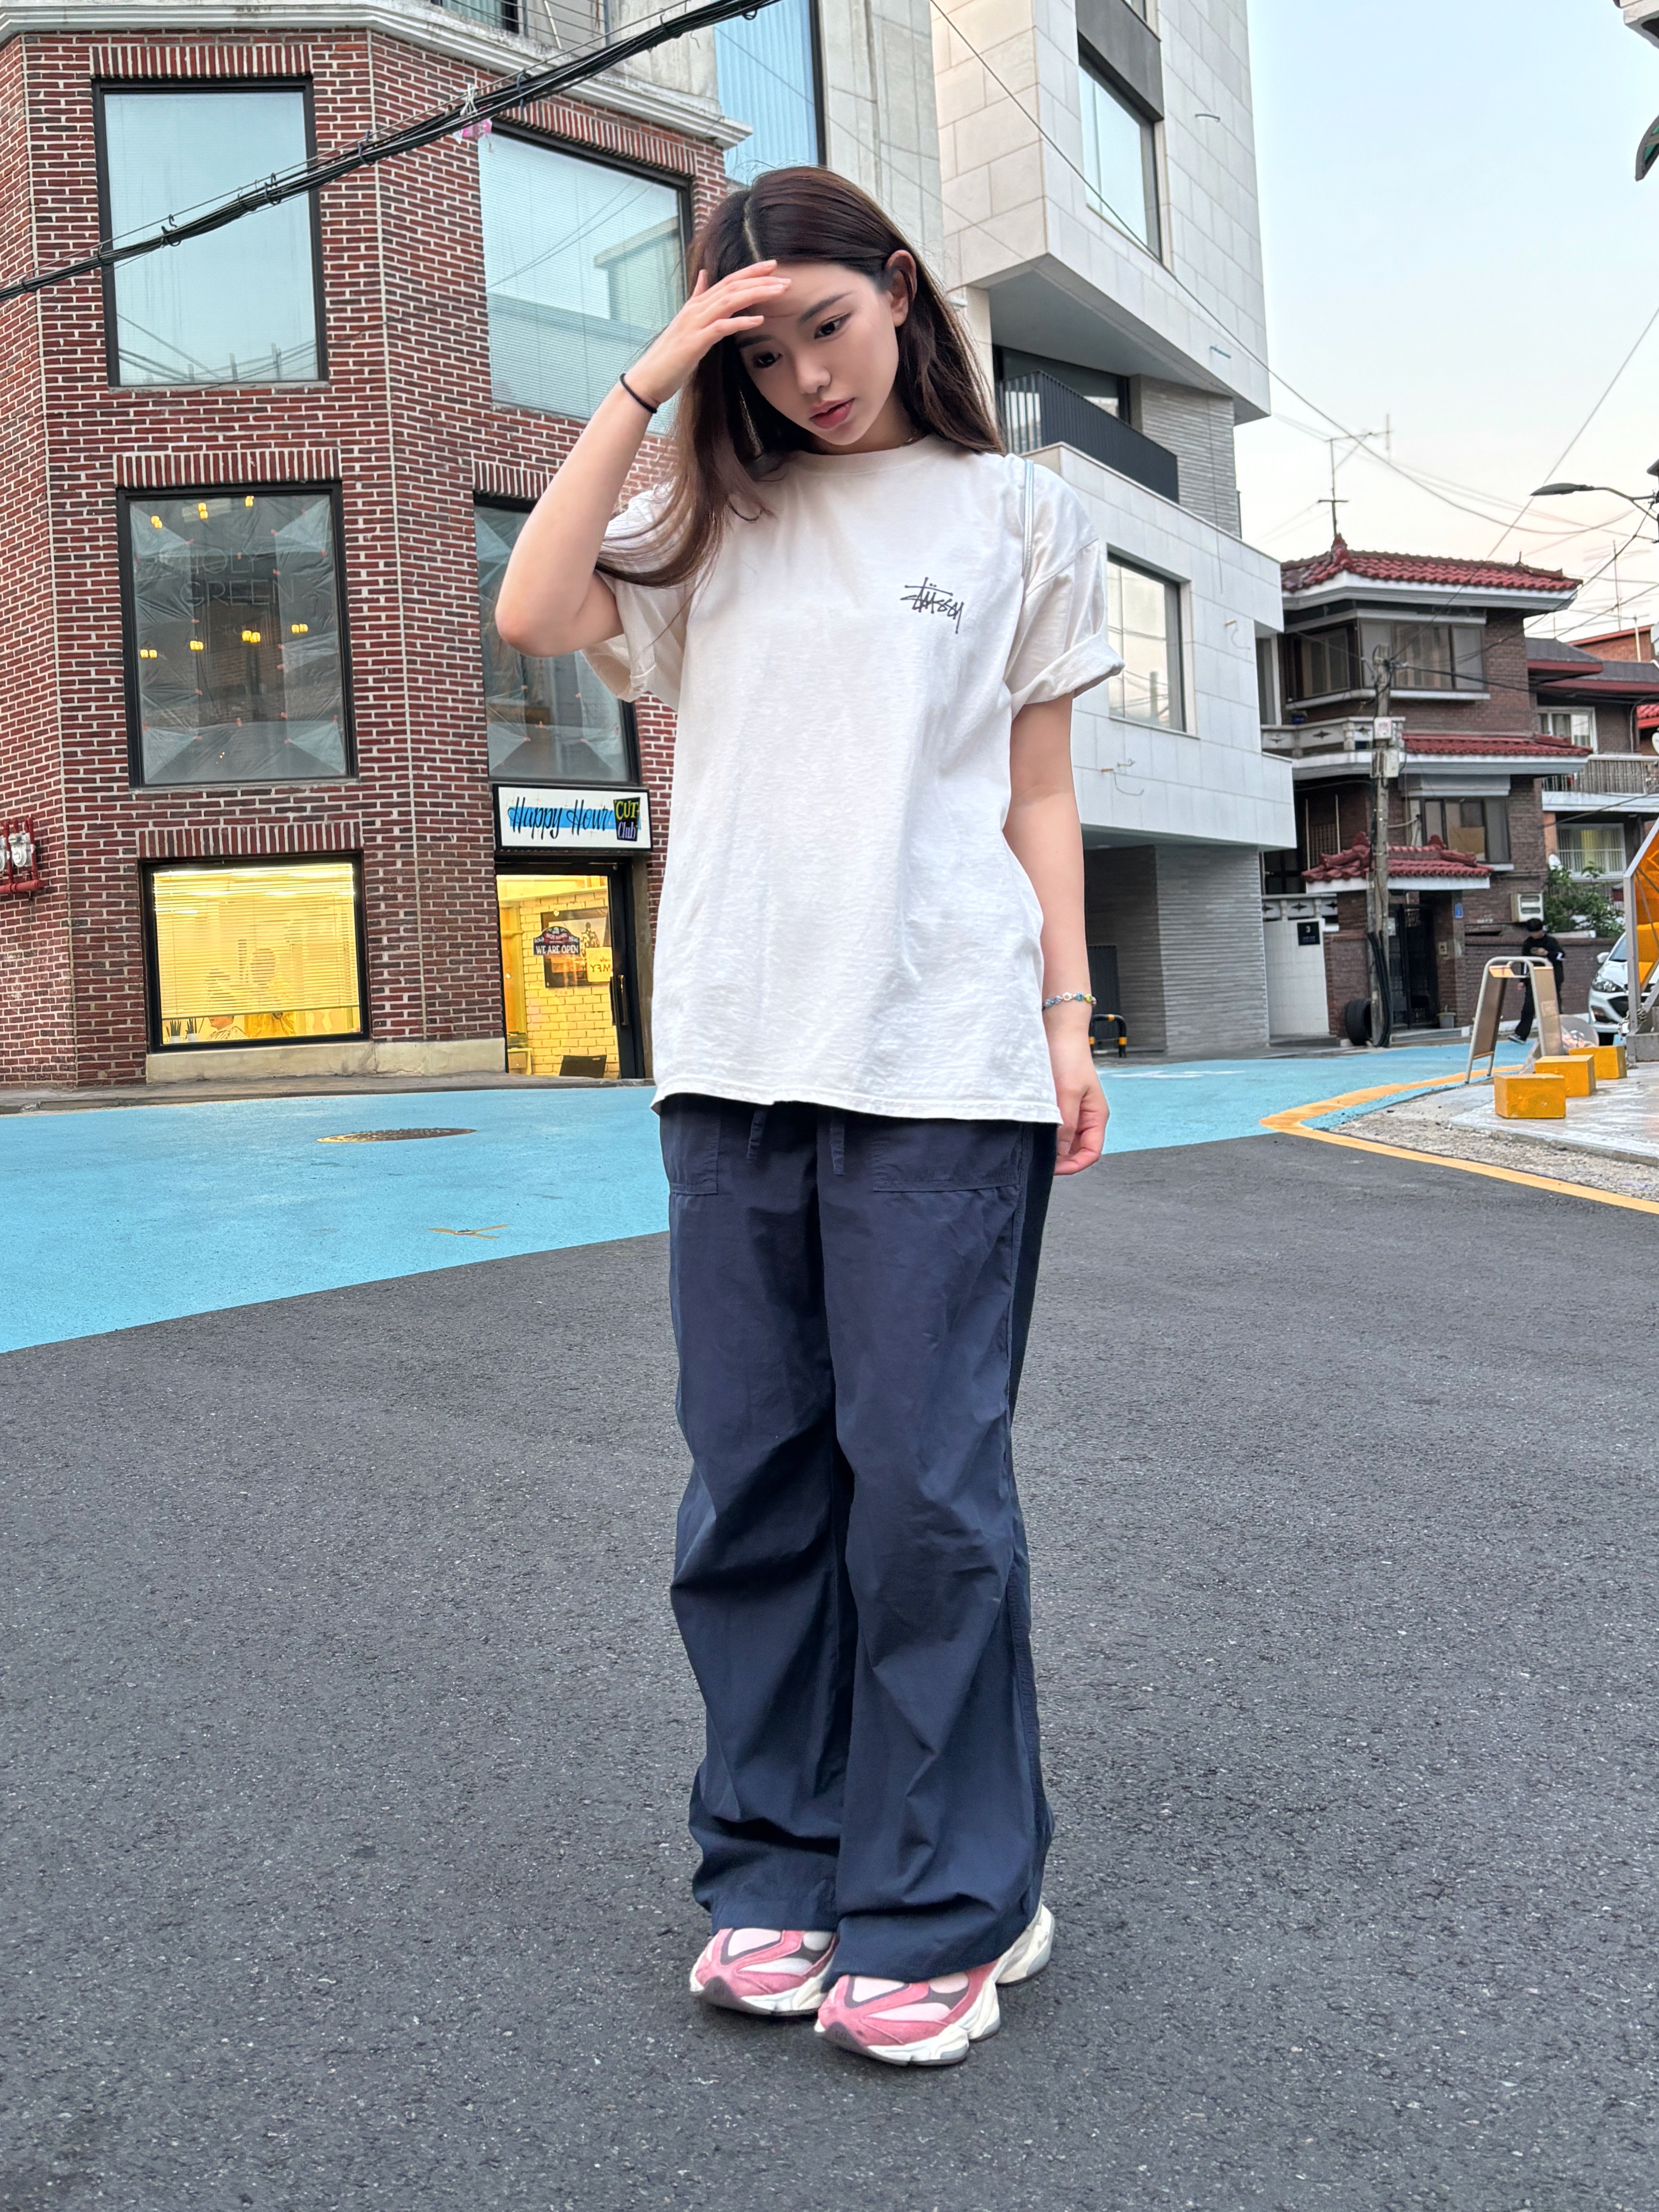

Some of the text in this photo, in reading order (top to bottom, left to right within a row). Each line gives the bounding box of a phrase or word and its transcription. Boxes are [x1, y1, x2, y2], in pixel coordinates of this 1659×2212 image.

[180, 579, 294, 607] GREEN
[508, 796, 612, 840] Happy Hour
[616, 800, 639, 820] CUT
[618, 821, 636, 839] Club
[536, 944, 578, 955] WE ARE OPEN
